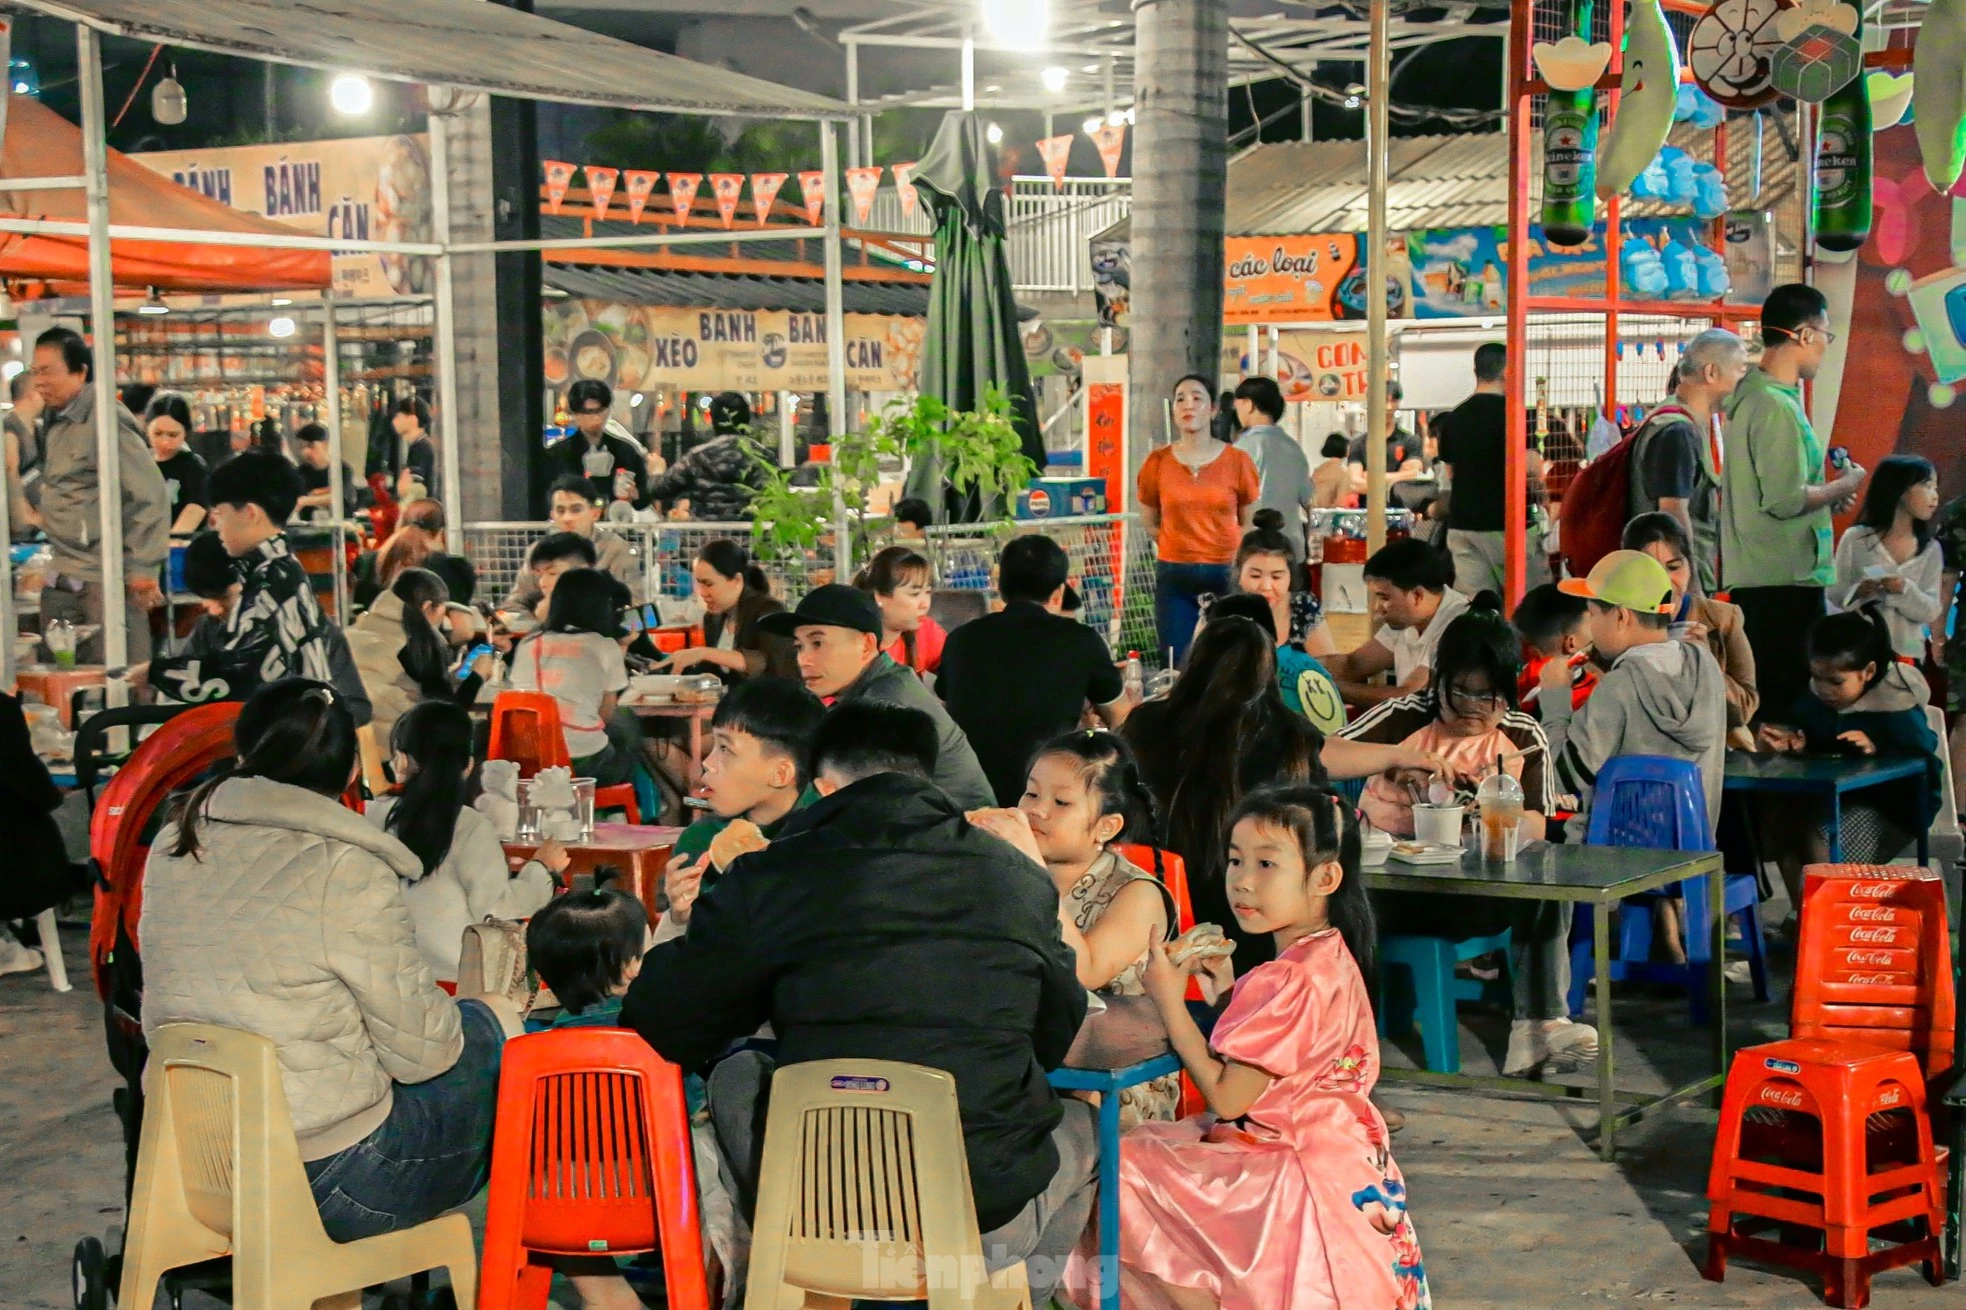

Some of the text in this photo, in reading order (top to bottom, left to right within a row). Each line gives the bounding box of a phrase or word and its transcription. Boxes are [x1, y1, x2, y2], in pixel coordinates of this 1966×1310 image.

[173, 163, 232, 207] ÁNH
[263, 155, 322, 217] BÁNH
[328, 195, 369, 256] CĂN
[1229, 246, 1318, 279] các loại
[655, 330, 698, 369] XÈO
